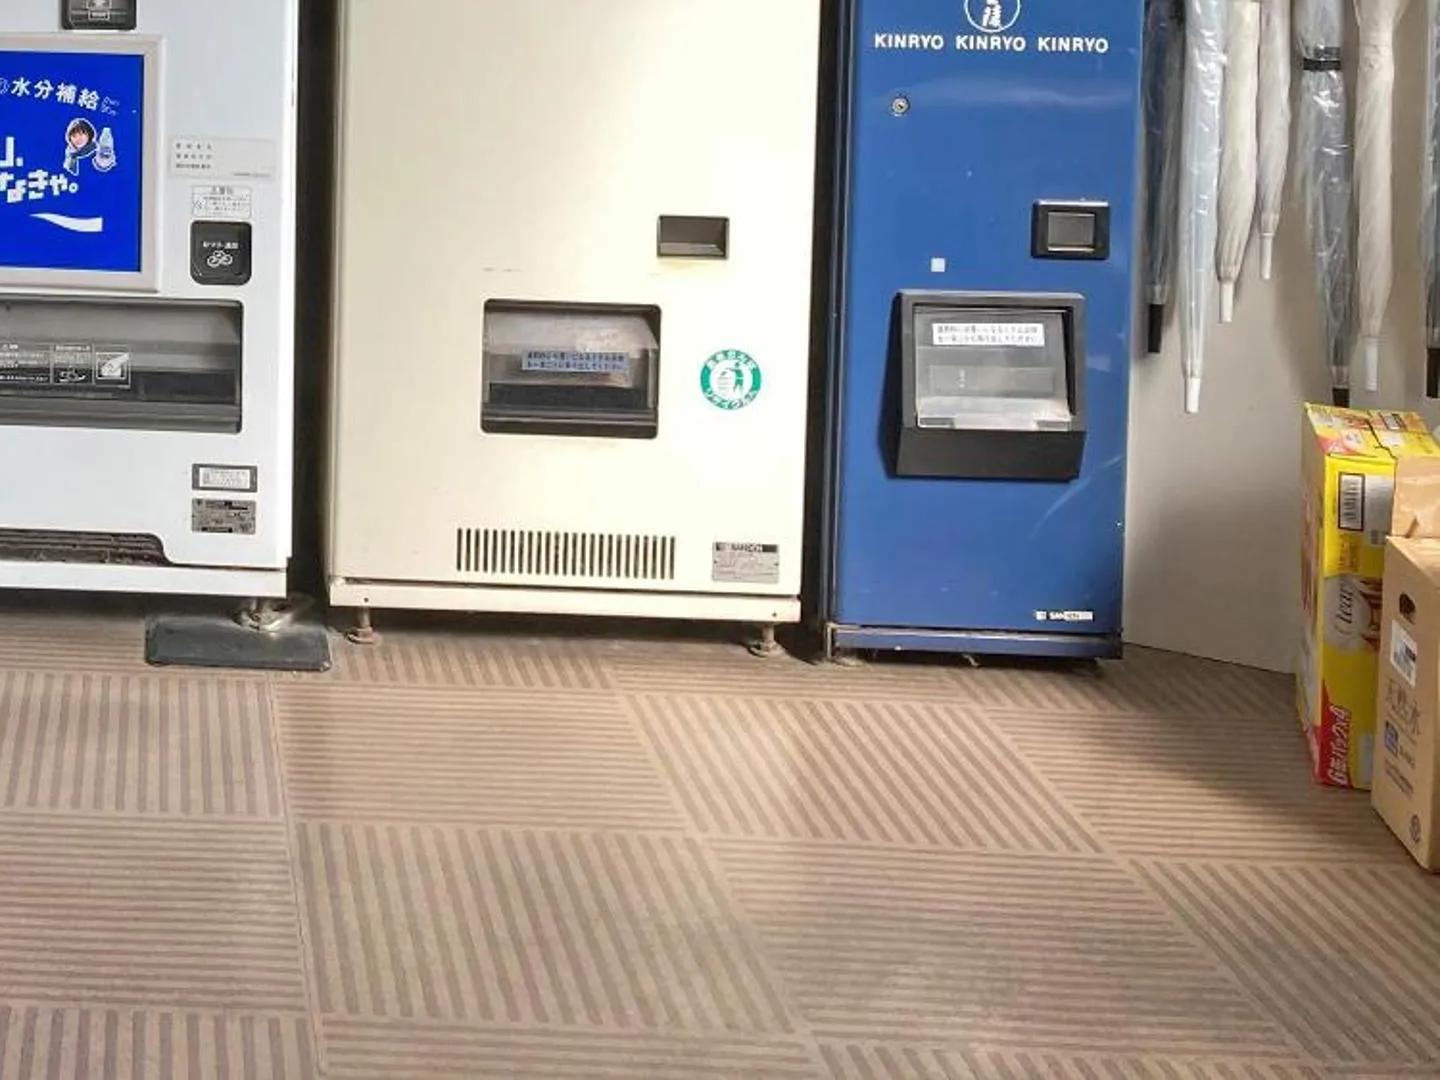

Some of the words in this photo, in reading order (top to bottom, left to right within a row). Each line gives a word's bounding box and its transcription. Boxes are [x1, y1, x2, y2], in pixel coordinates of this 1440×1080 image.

[874, 32, 945, 50] KINRYO
[955, 34, 1027, 52] KINRYO
[1037, 36, 1109, 54] KINRYO
